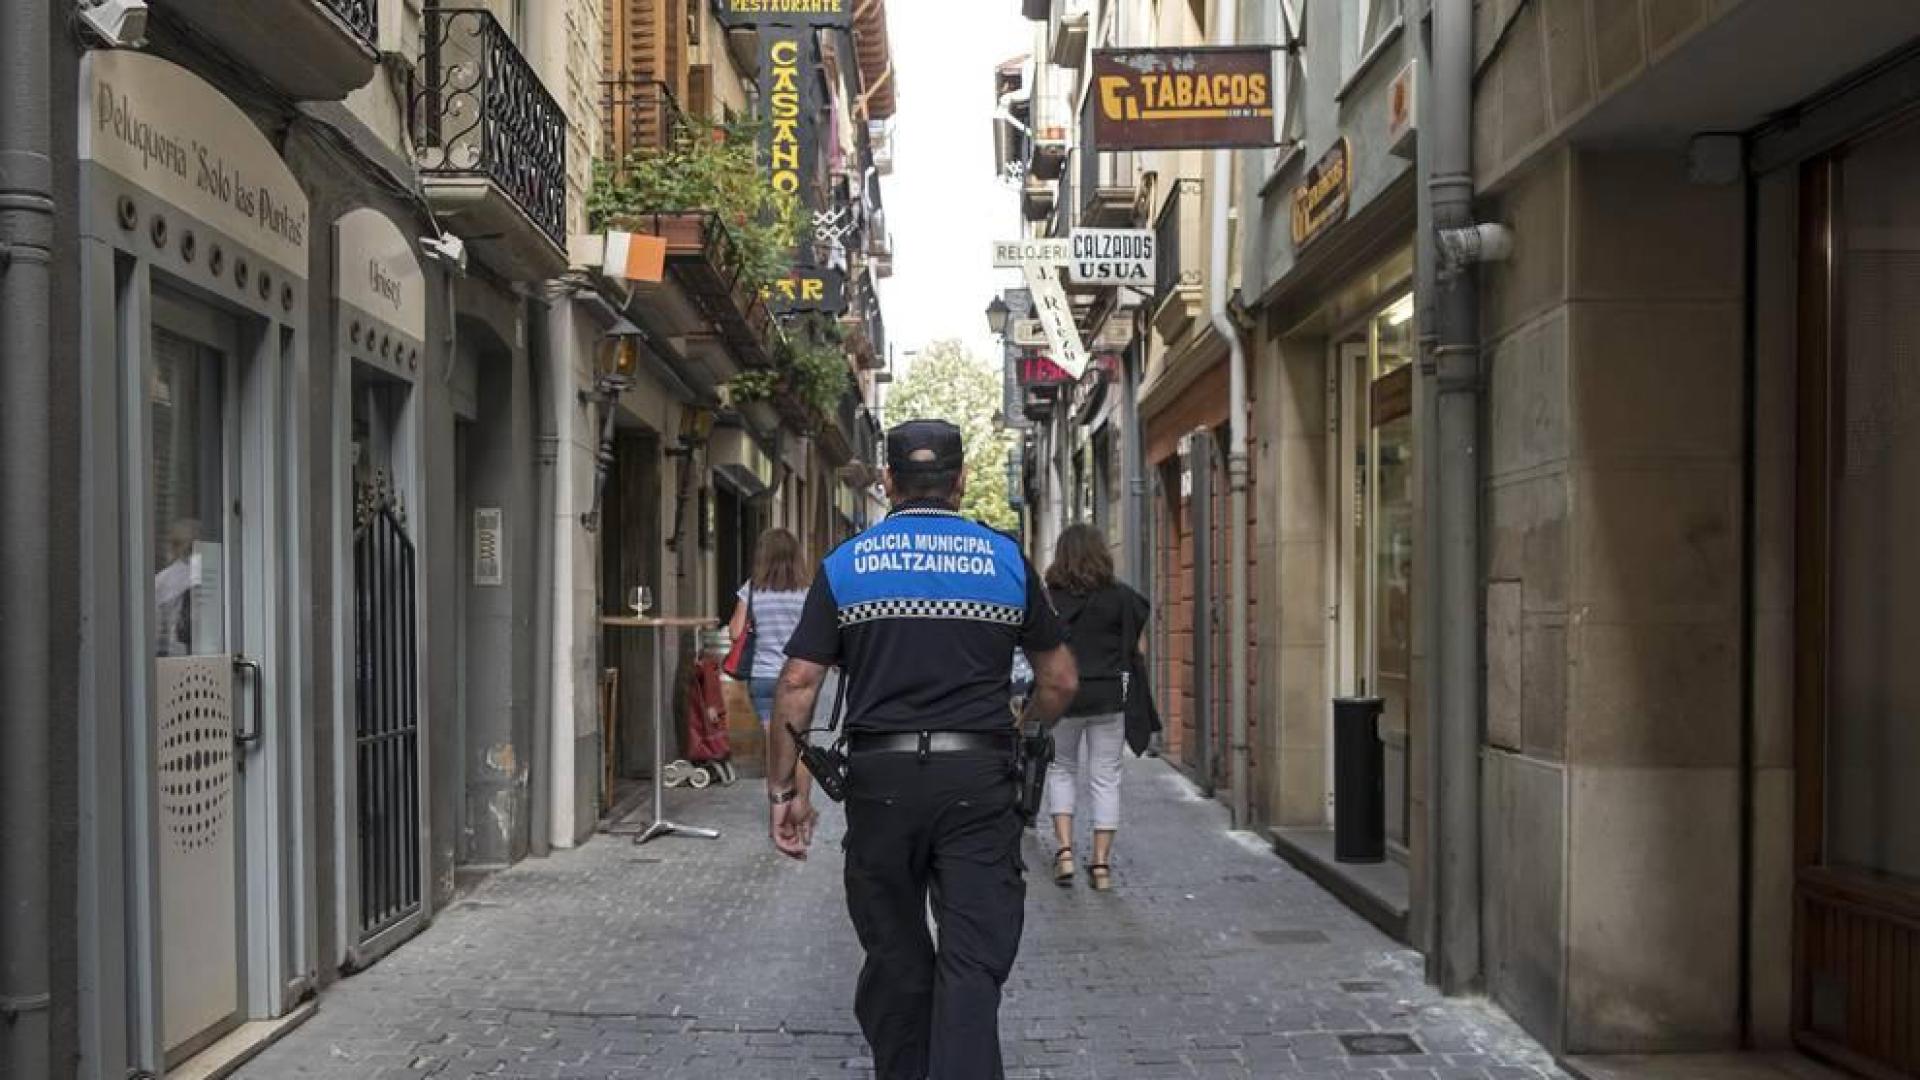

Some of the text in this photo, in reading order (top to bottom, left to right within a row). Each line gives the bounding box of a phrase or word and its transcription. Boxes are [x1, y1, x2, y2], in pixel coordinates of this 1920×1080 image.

[731, 0, 842, 12] RESTAURANTE
[1141, 74, 1266, 107] TABACOS
[235, 170, 255, 217] las
[997, 245, 1069, 260] RELOJERI
[1073, 234, 1153, 259] CALZADOS
[1079, 263, 1147, 278] USUA
[758, 279, 823, 301] AR
[854, 533, 994, 556] POLICIA MUNICIPAL
[854, 552, 996, 577] UDALTZAINGOA
